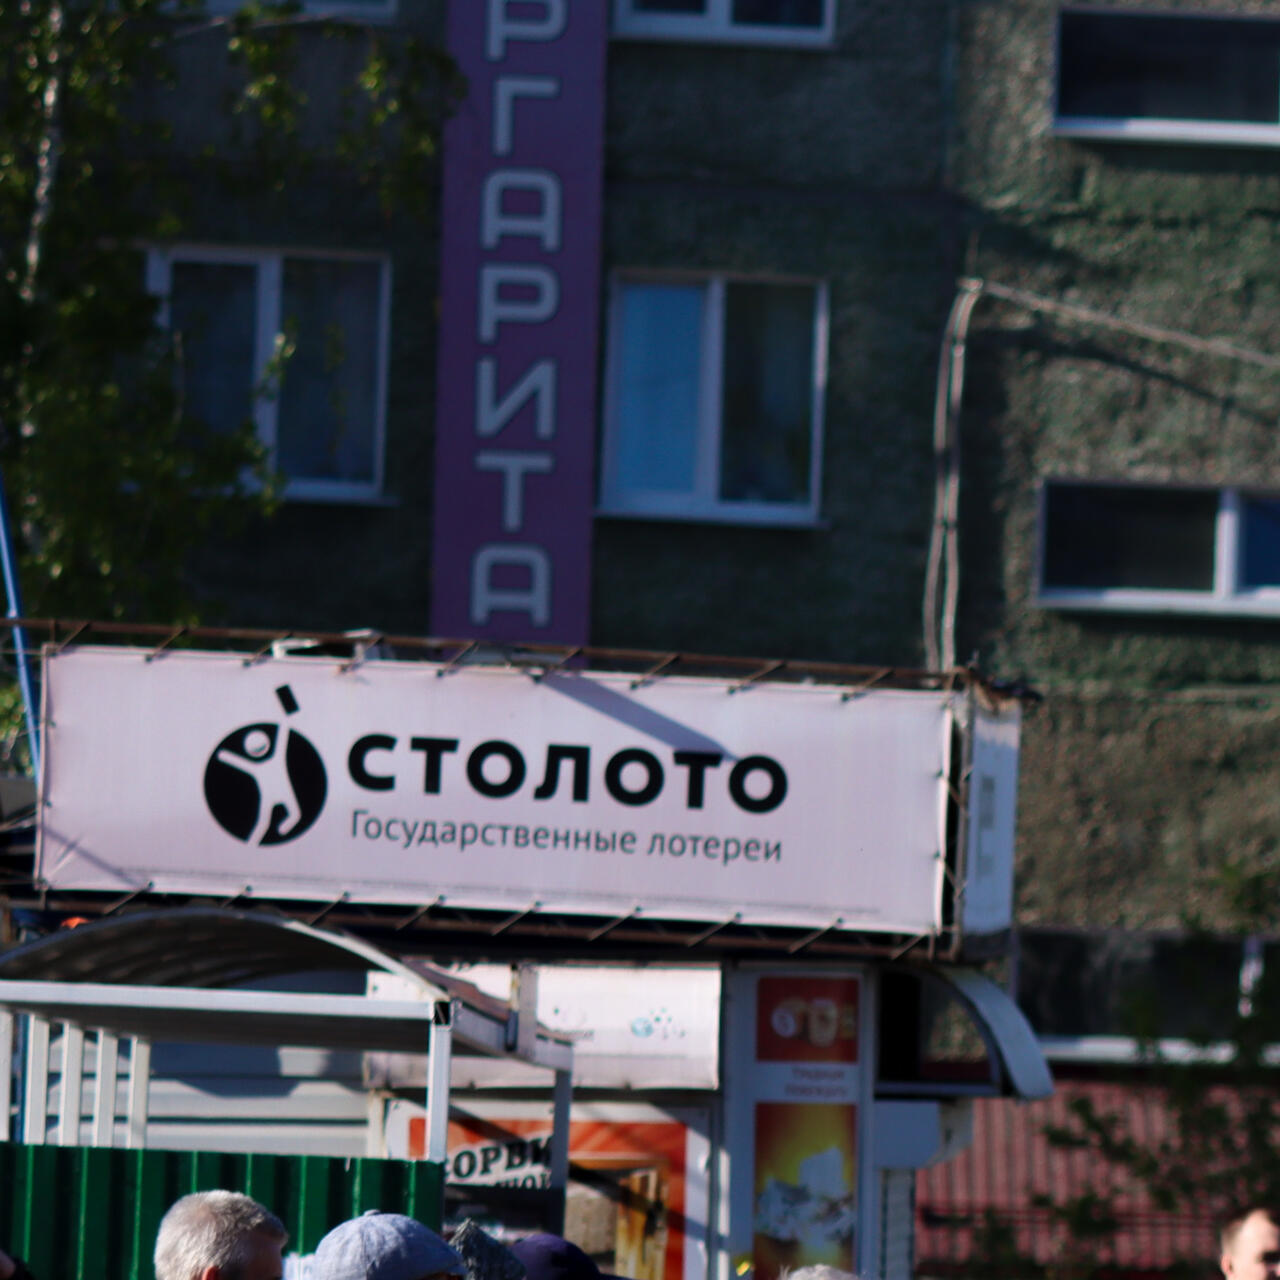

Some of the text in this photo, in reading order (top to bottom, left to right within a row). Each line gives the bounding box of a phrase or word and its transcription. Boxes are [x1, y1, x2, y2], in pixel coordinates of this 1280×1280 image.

[349, 807, 783, 865] Государственные лотереи
[445, 1135, 553, 1180] ОРВИ
